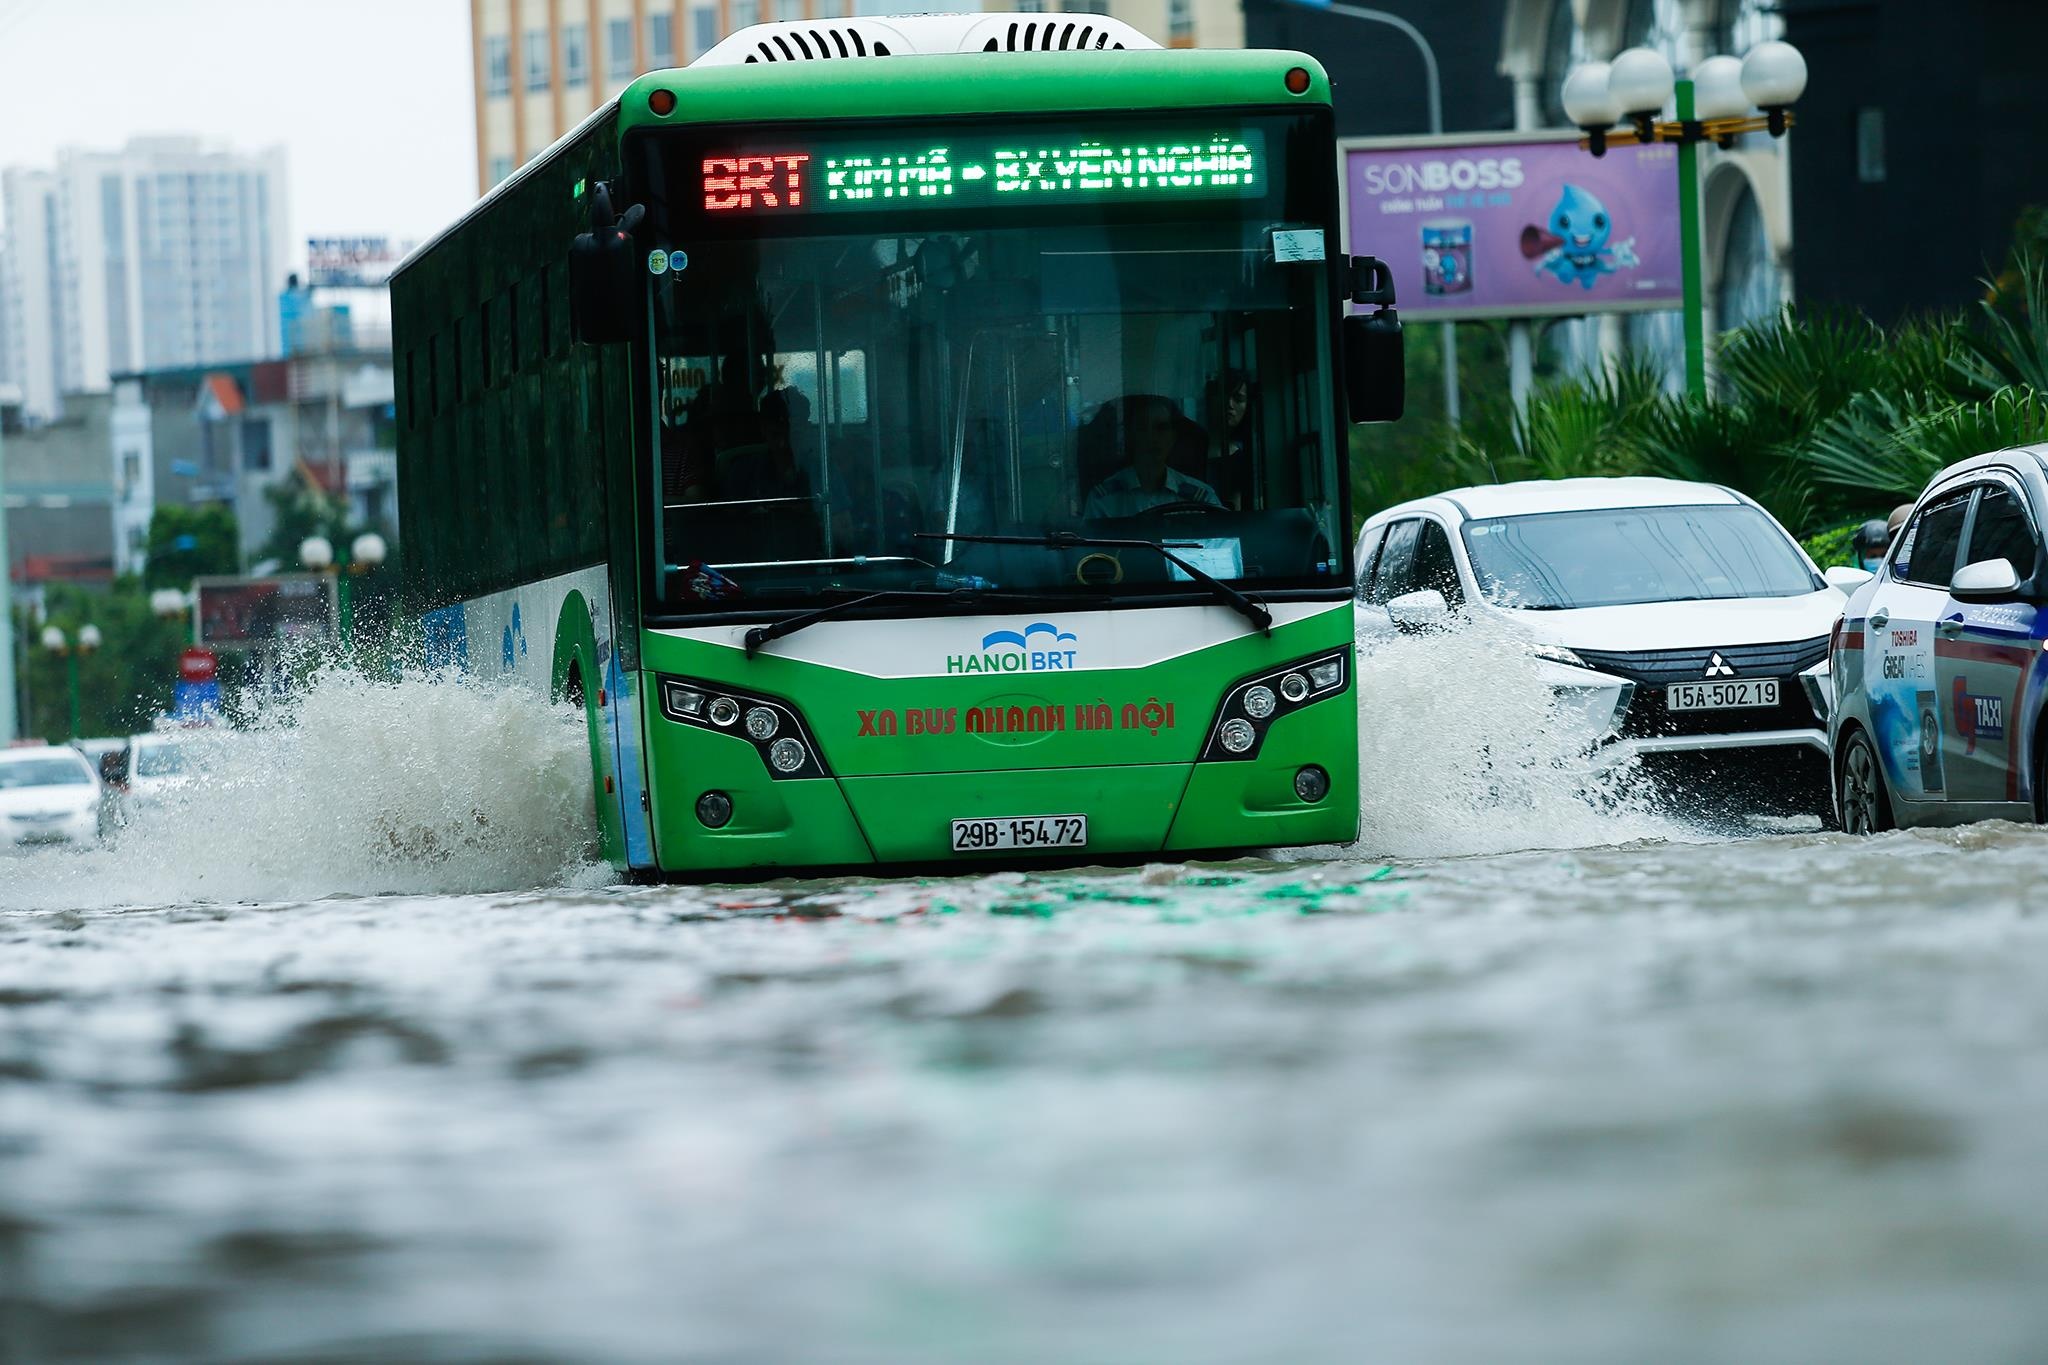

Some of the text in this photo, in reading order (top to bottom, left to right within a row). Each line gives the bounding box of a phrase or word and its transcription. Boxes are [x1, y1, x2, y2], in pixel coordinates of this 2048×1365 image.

[703, 156, 809, 210] BRT
[826, 156, 893, 200] KIM
[1364, 157, 1525, 195] SONBOSS
[1891, 630, 1917, 647] TOSHIBA
[946, 650, 1077, 674] HANOI BRT
[1883, 655, 1905, 679] GREAT
[1673, 682, 1776, 708] 15A-502.19
[856, 696, 1175, 737] XN BUS NHANH HÀ NỘI
[1974, 698, 2002, 728] TAXI
[955, 818, 1084, 848] 29B-154.72
